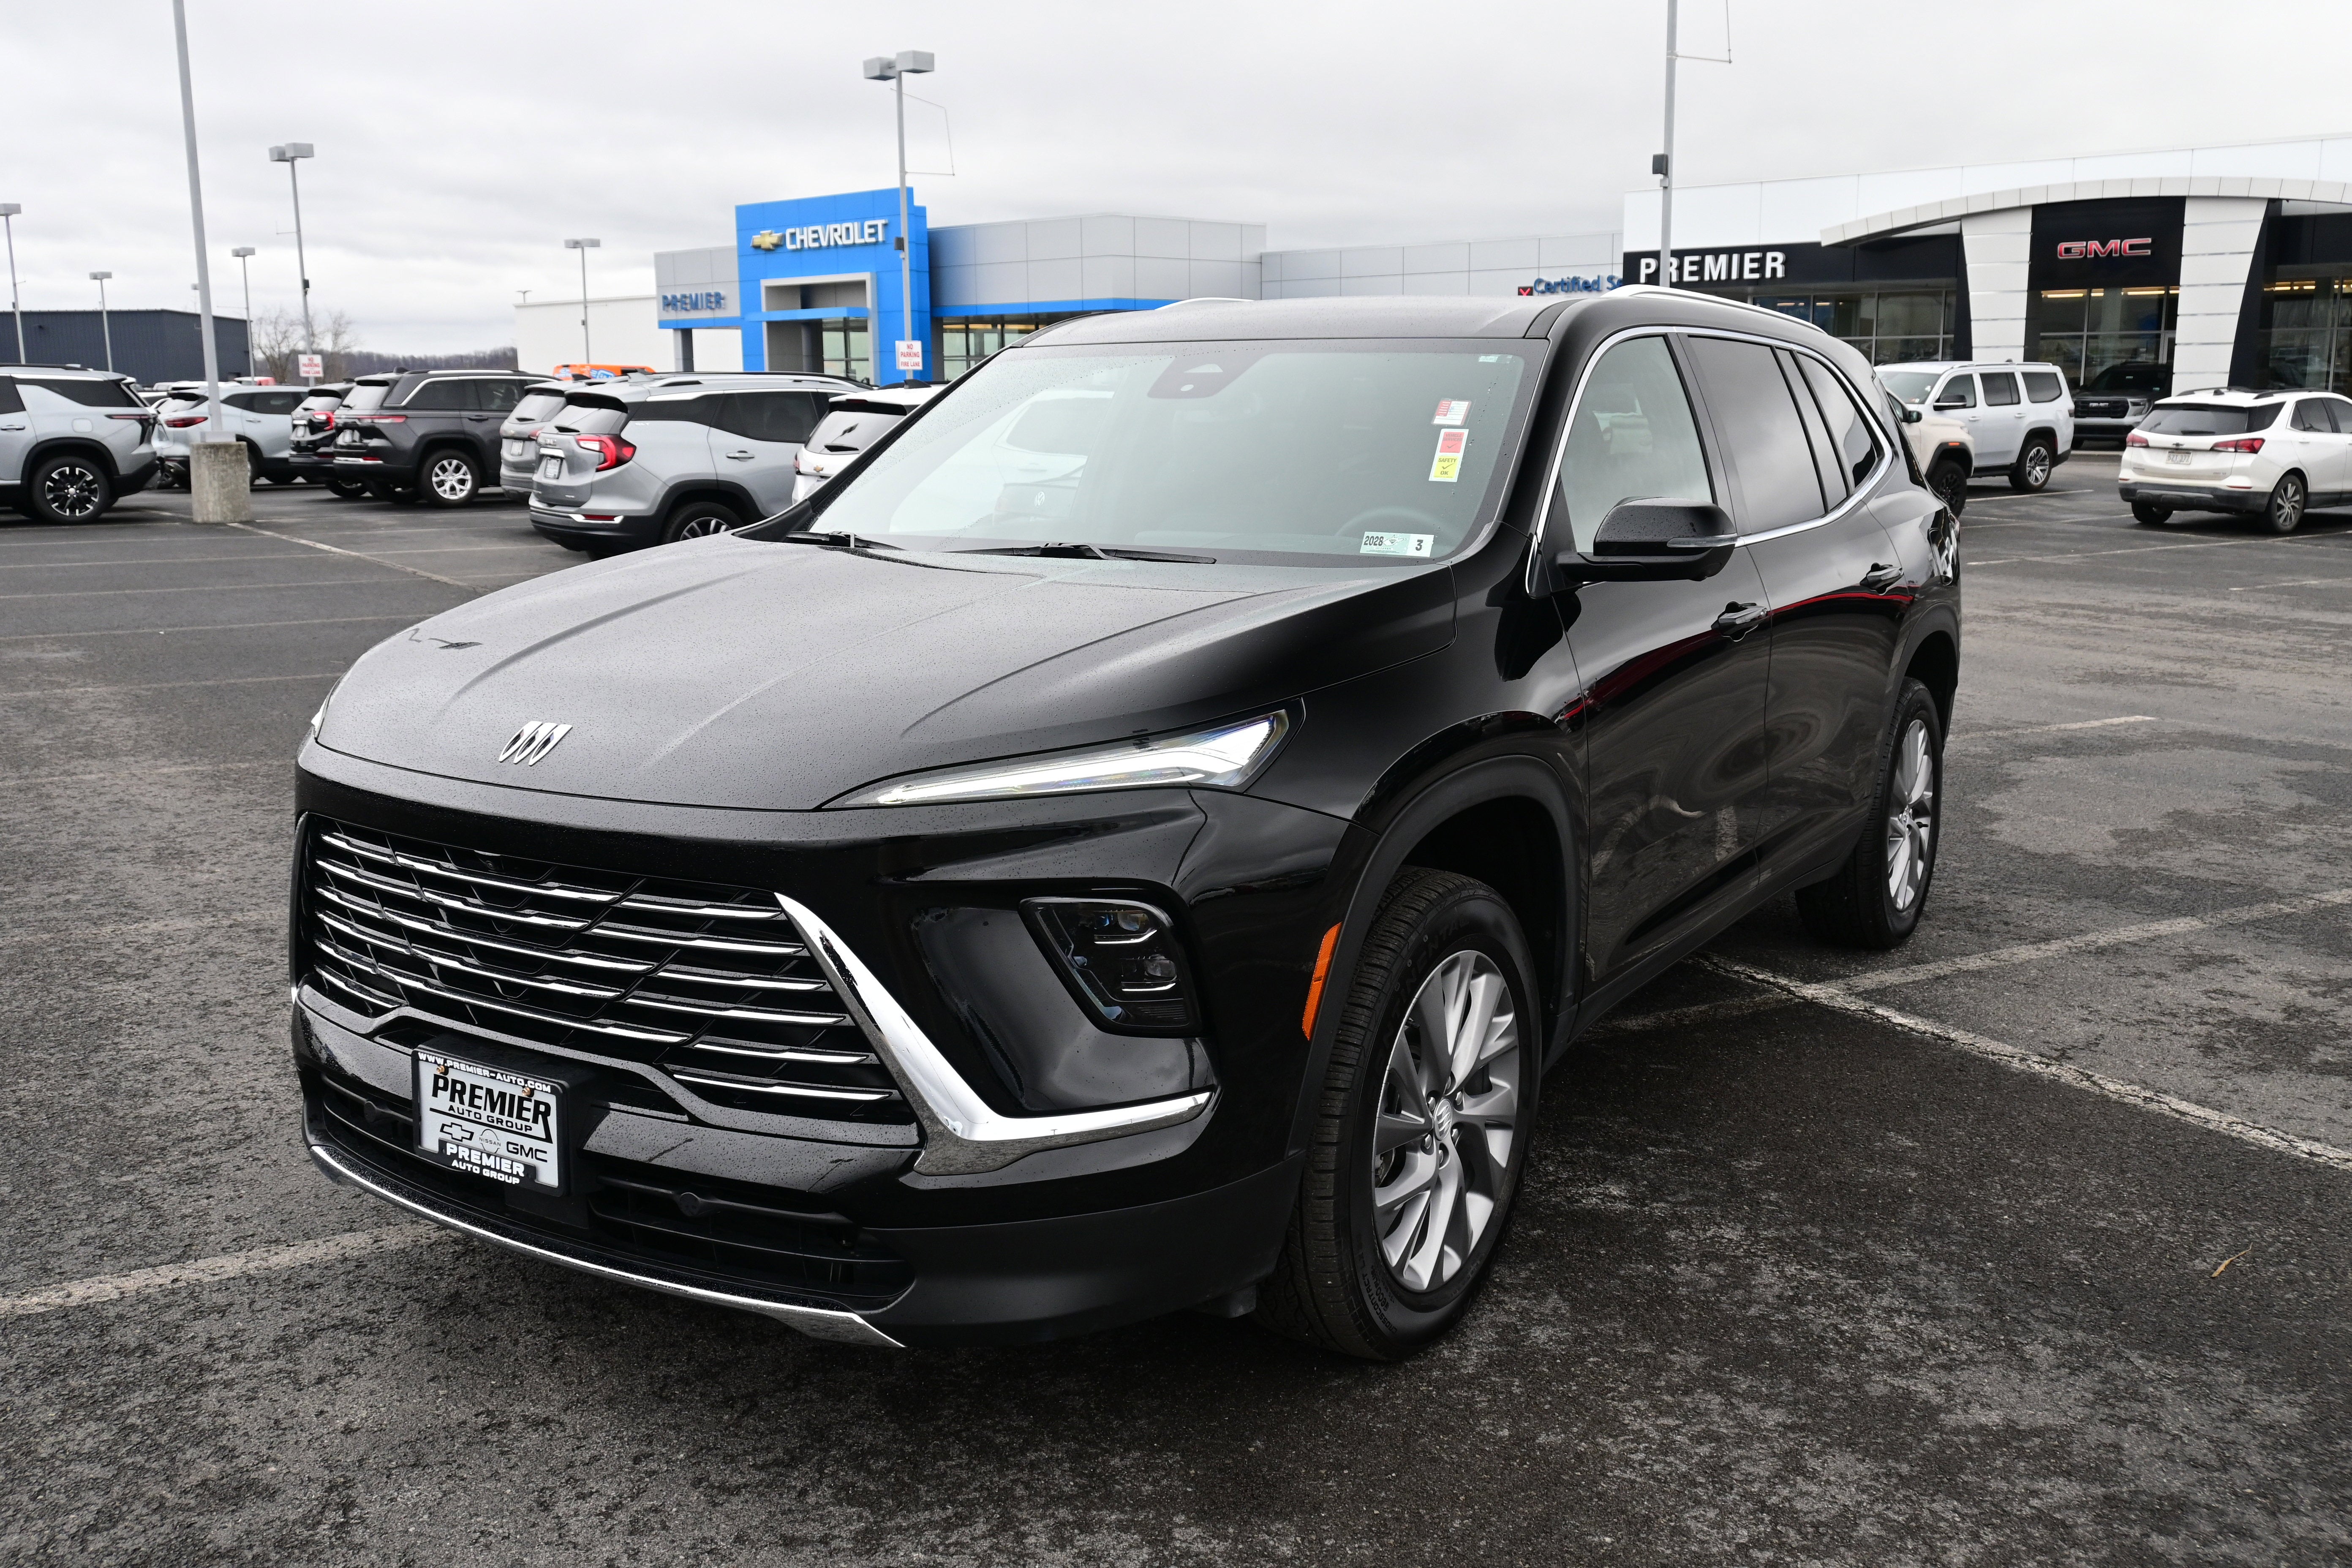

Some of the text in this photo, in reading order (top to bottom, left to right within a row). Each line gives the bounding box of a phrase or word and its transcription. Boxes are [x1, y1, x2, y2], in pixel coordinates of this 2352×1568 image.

[786, 219, 888, 249] CHEVROLET
[2058, 237, 2152, 259] GMC
[1640, 251, 1786, 283] PREMIER
[1534, 275, 1601, 294] Certified
[662, 291, 724, 311] PREMIER
[1364, 536, 1424, 551] 2028 3
[418, 1052, 551, 1093] WWW.PREMIER-AUTO.COM
[432, 1073, 552, 1127] PREMIER
[448, 1105, 533, 1132] AUTO GROUP
[446, 1142, 525, 1177] PREMIER
[479, 1137, 548, 1163] NISSAN GMC
[452, 1160, 520, 1184] AUTO GROUP
